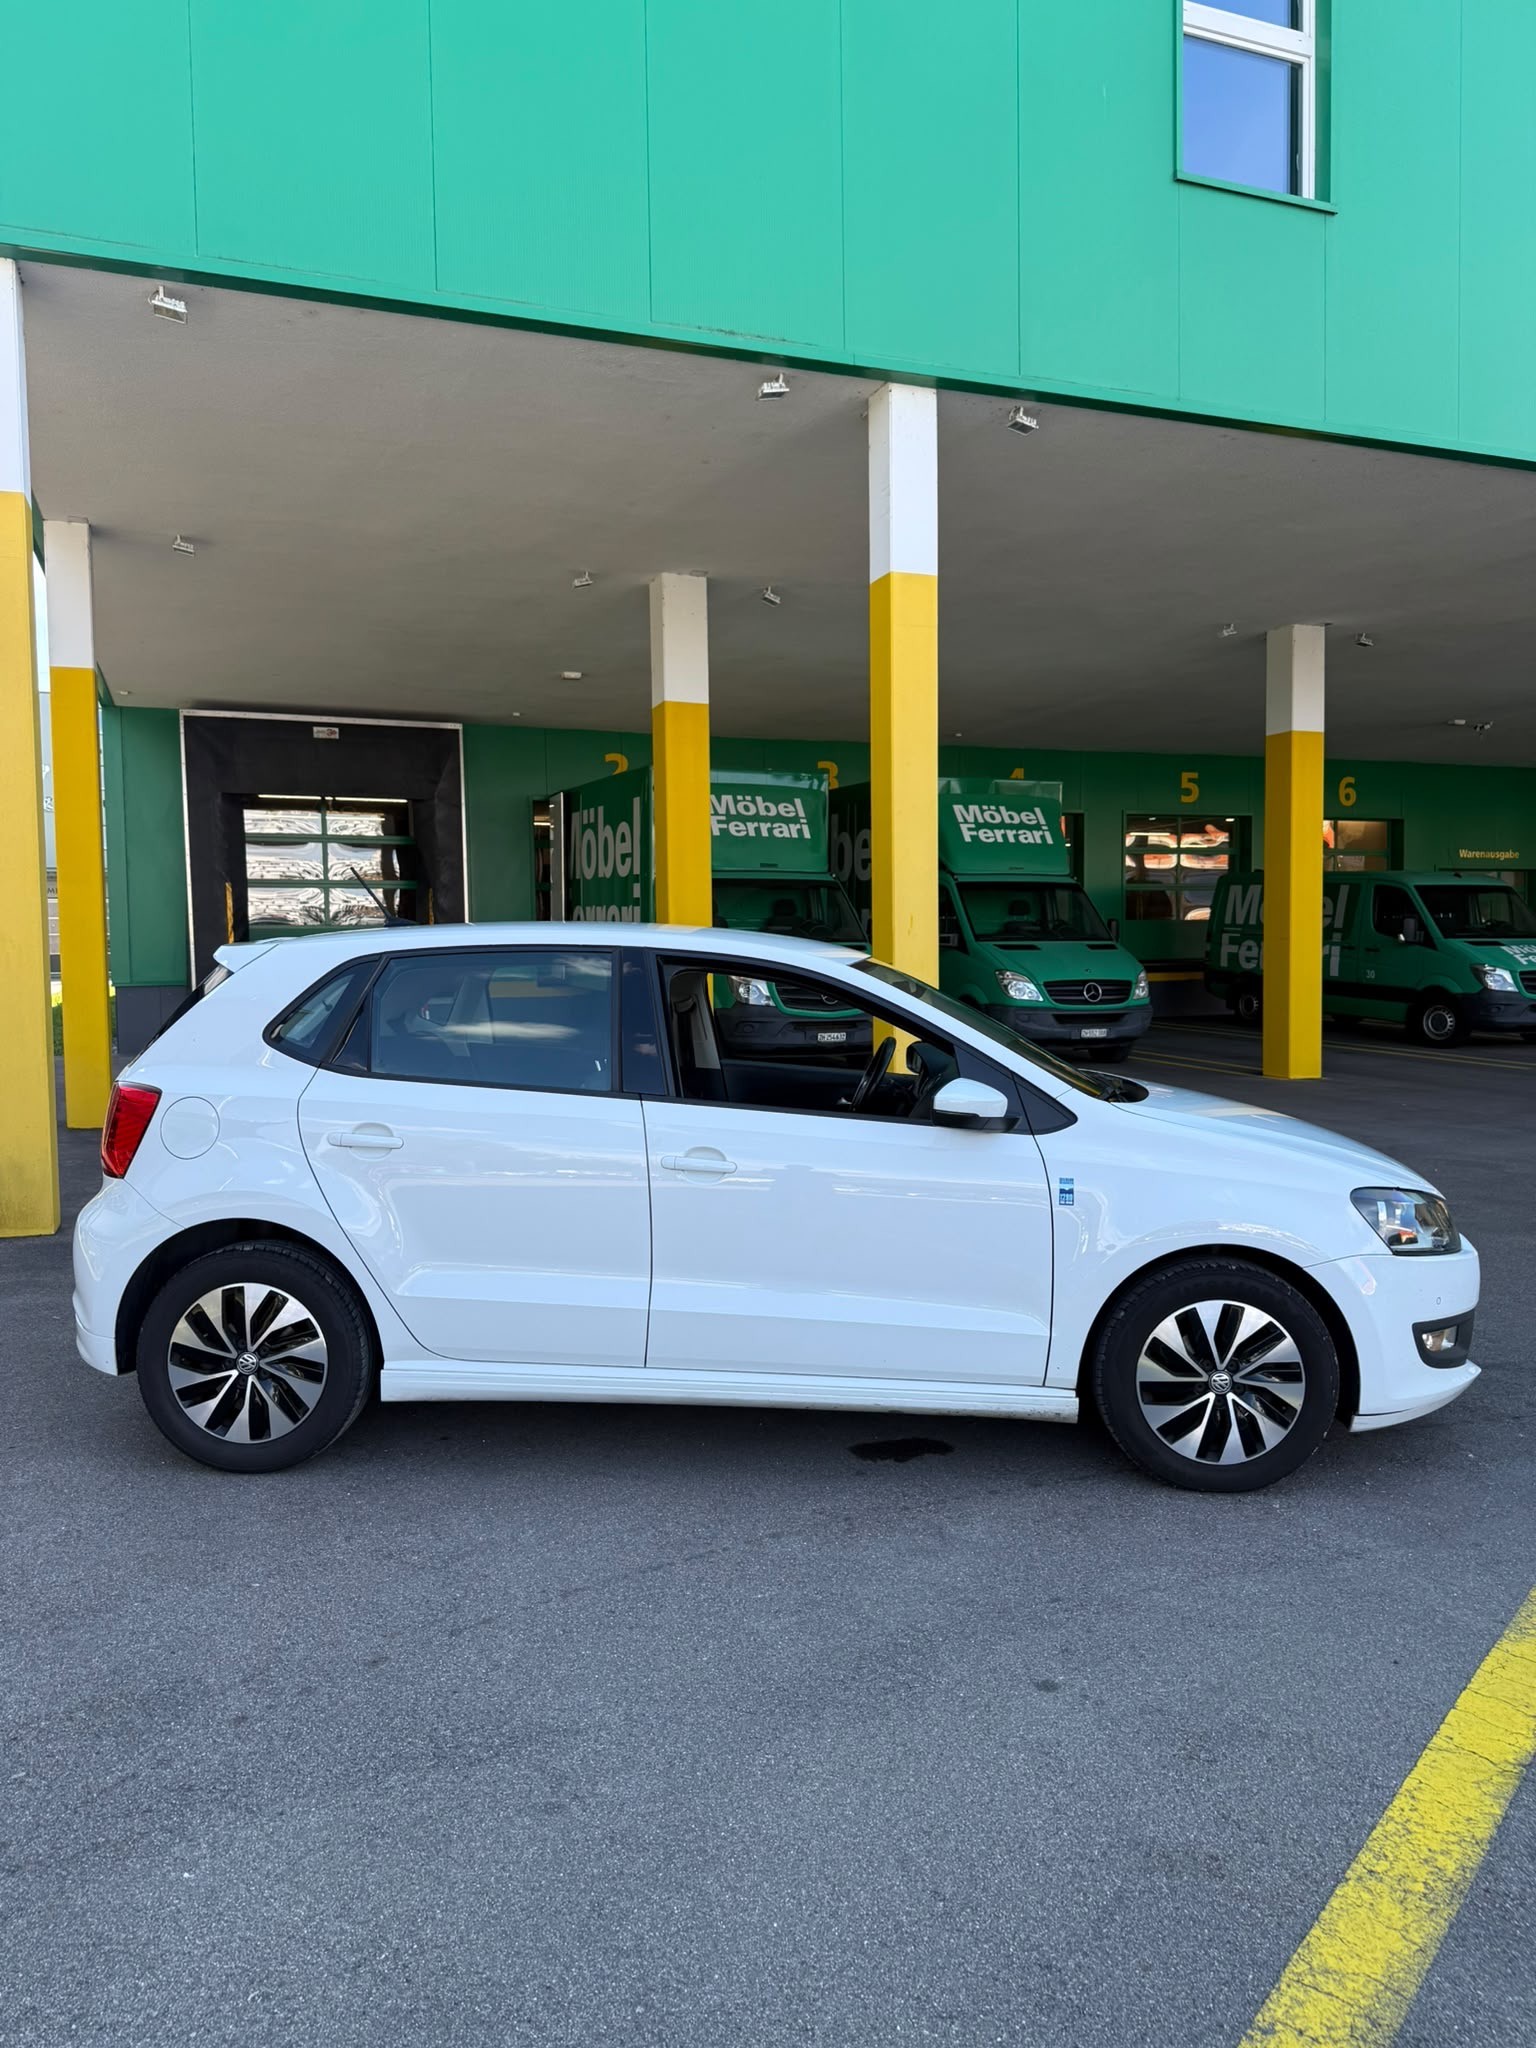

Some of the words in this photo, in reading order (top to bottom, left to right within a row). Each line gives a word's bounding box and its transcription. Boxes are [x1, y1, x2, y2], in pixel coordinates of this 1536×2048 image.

[1181, 772, 1199, 802] 5
[1338, 776, 1356, 806] 6
[711, 795, 805, 817] Möbel
[952, 804, 1047, 825] Möbel
[711, 816, 811, 839] Ferrari
[960, 823, 1053, 844] Ferrari
[1459, 849, 1519, 860] Warenausgabe
